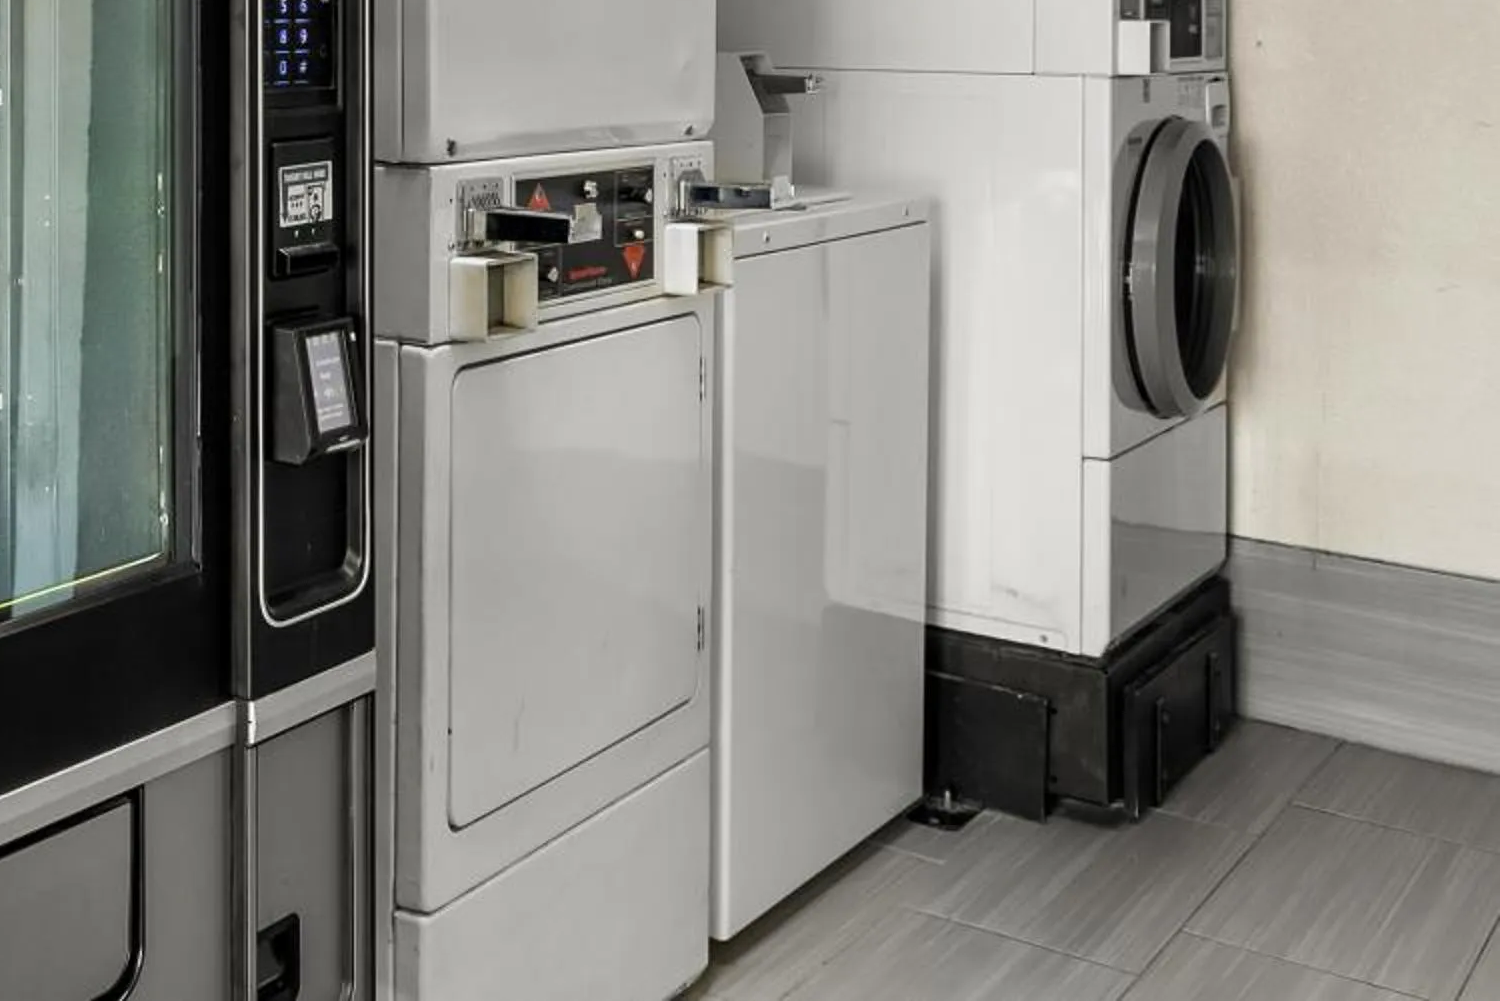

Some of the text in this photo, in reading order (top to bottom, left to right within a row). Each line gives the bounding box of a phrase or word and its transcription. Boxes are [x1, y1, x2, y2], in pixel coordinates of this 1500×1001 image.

[280, 28, 308, 44] 8 9
[280, 60, 288, 75] 0
